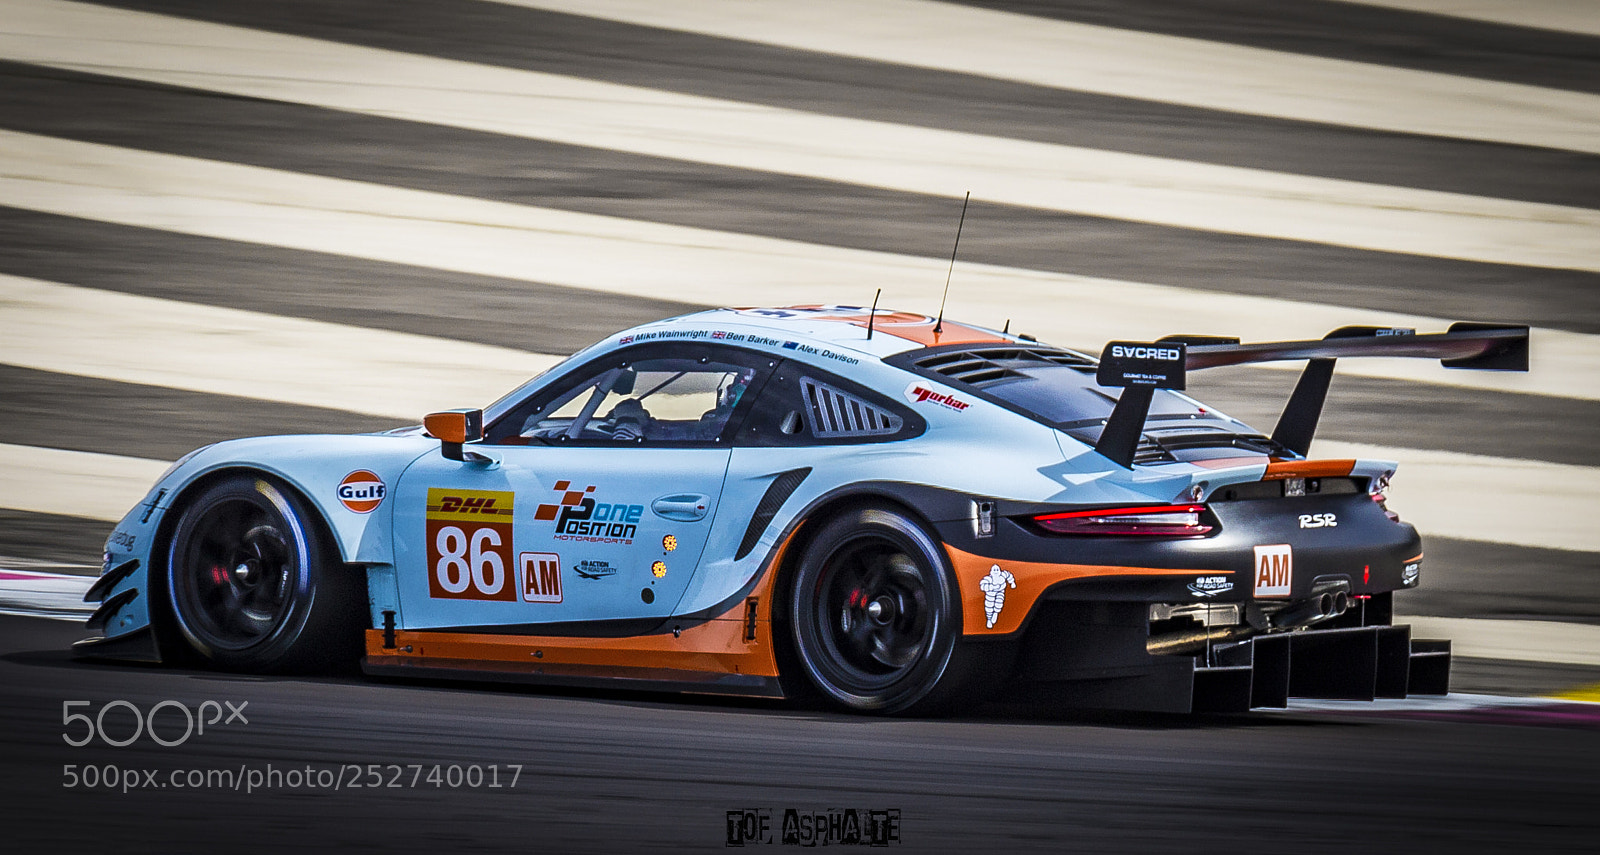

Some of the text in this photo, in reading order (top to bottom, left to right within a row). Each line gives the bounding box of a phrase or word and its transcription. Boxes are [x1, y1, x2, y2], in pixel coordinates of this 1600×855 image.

[635, 330, 708, 342] Mike Wainwright
[726, 332, 779, 347] Ben Barker
[797, 344, 859, 366] Alex Davison
[339, 484, 385, 499] Gulf
[440, 496, 500, 513] DHL
[1299, 513, 1337, 529] RSR
[554, 535, 633, 545] MOTORSPORTS
[436, 526, 505, 595] 86
[525, 560, 559, 596] AM
[1257, 554, 1289, 588] AM
